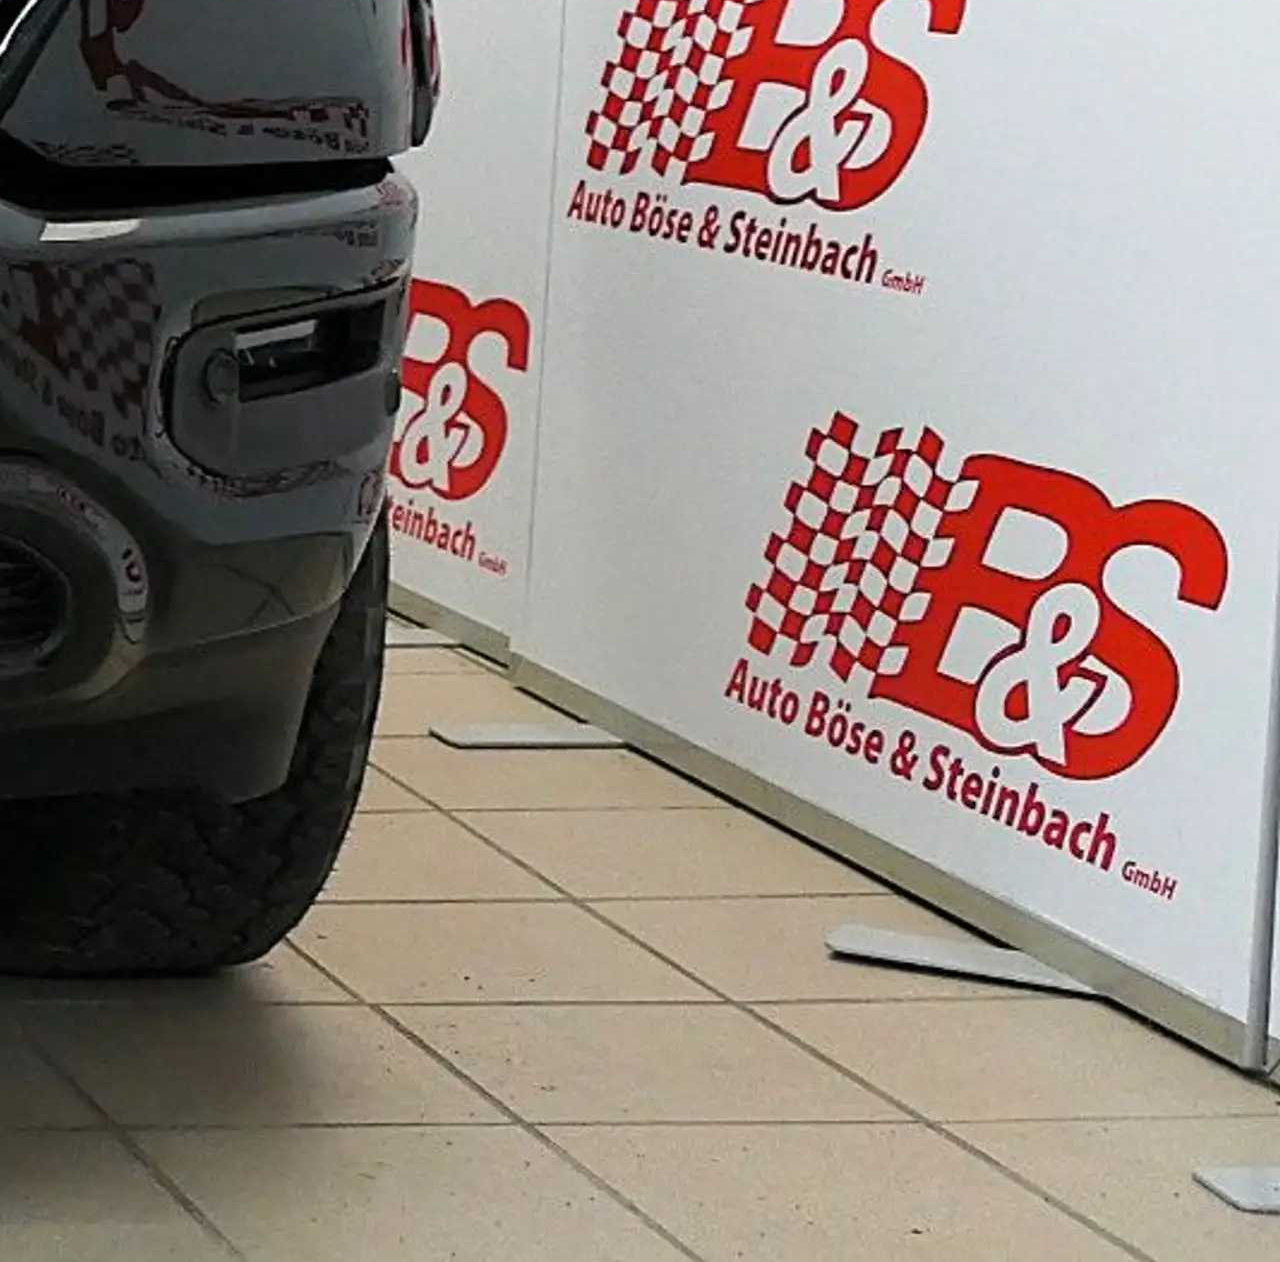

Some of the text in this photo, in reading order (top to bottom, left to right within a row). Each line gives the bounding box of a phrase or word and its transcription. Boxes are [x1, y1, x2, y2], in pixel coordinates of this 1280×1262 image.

[567, 180, 925, 295] Auto Böse & Steinbach GmbH
[392, 499, 476, 560] einbach
[724, 659, 1178, 900] Auto Böse & Steinbach GmbH
